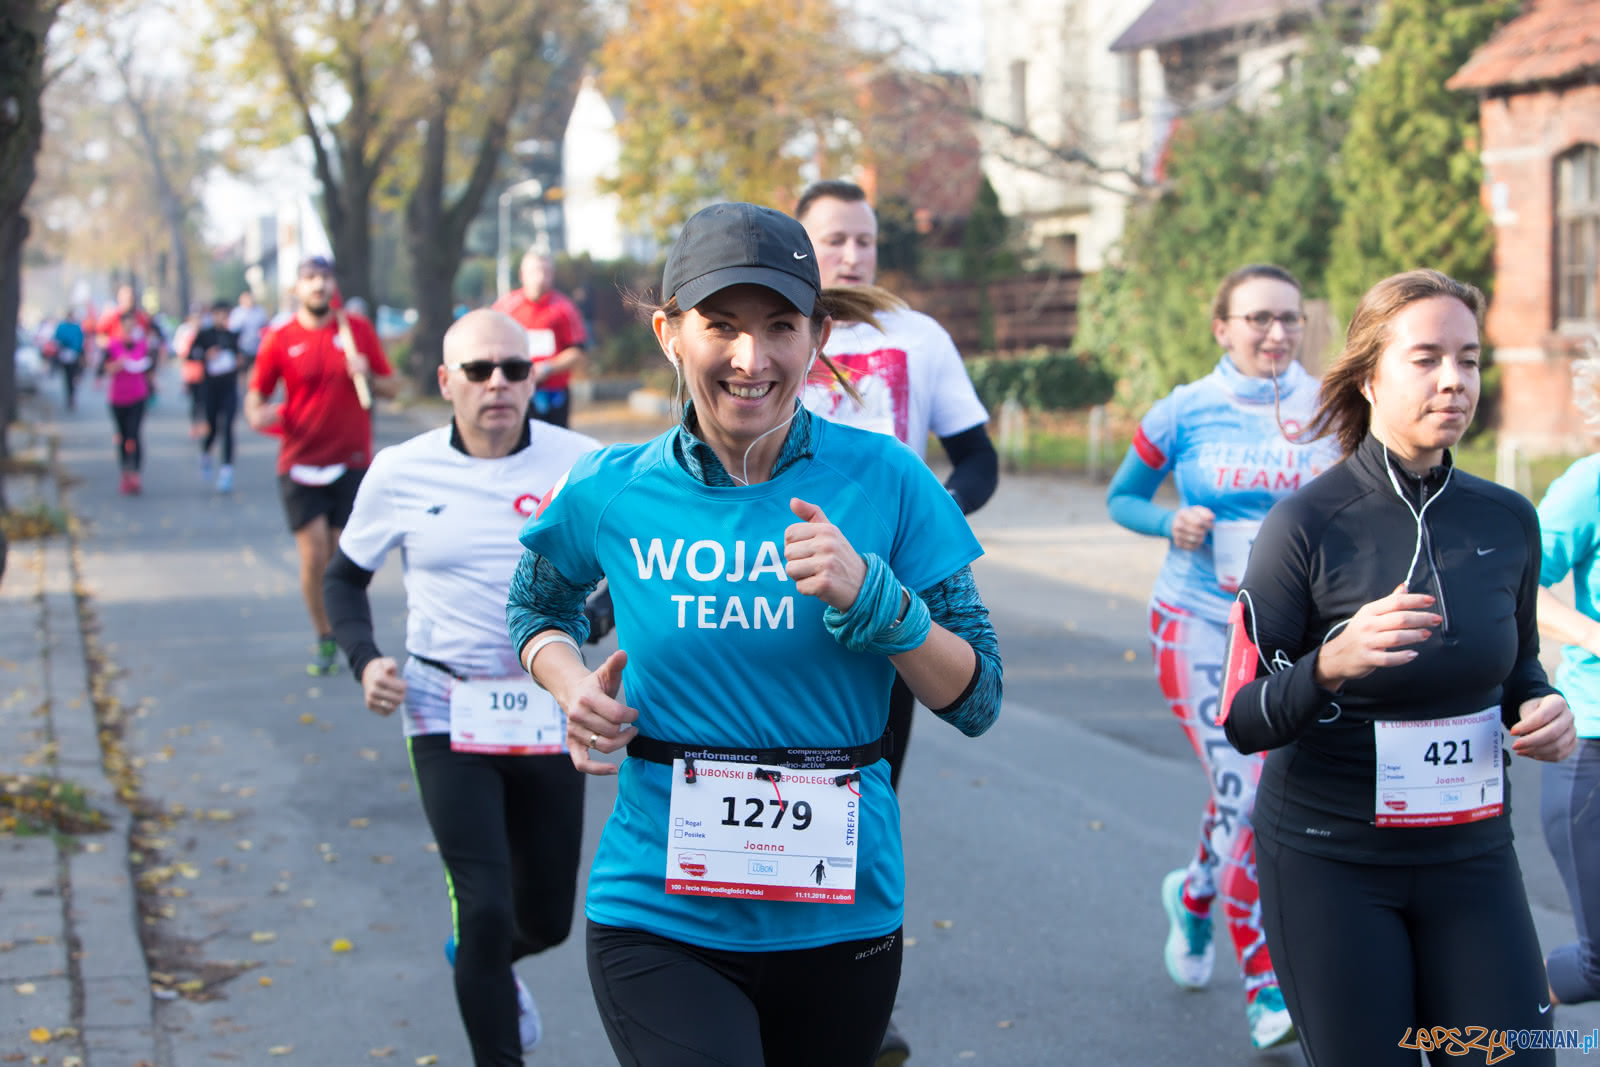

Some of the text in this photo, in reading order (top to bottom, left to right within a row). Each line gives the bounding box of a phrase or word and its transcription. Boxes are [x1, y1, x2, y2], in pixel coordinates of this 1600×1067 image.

[1216, 466, 1301, 491] TEAM
[629, 538, 789, 583] WOJA
[671, 594, 795, 630] TEAM
[490, 691, 528, 712] 109
[684, 749, 758, 762] performance
[804, 754, 851, 762] anti-shock
[1424, 739, 1473, 766] 421
[695, 767, 745, 780] LUBOŃSKI
[780, 774, 837, 786] EPODLEGŁO
[1436, 776, 1465, 785] Joanna
[721, 796, 813, 831] 1279
[685, 819, 702, 828] Rogal
[845, 800, 856, 847] STREFA D
[743, 840, 785, 852] Joanna
[745, 888, 764, 897] Polski
[795, 891, 826, 899] 11.11.2018
